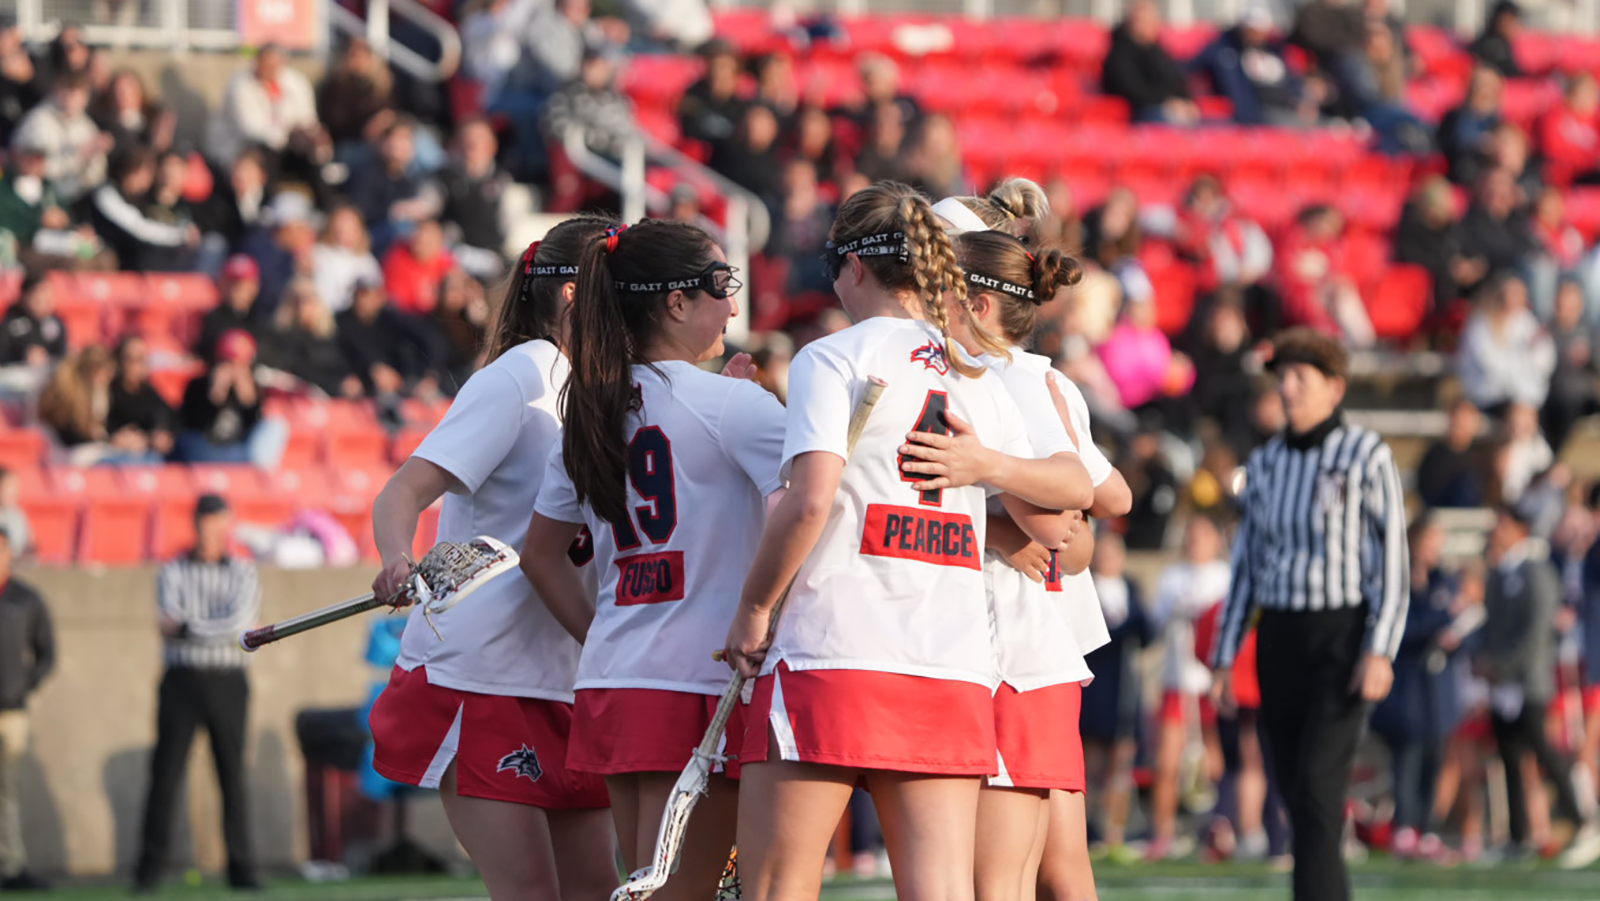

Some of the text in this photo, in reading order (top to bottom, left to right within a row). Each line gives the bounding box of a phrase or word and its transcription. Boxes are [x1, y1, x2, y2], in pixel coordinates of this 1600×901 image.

[837, 240, 859, 255] GAIT
[862, 233, 889, 246] GAIT
[536, 266, 556, 275] GAIT
[560, 266, 580, 274] GAI
[630, 283, 662, 291] GAIT
[668, 278, 700, 289] GAIT
[970, 273, 1000, 288] GAIT
[1002, 283, 1027, 296] GAIT
[883, 513, 974, 558] PEARCE
